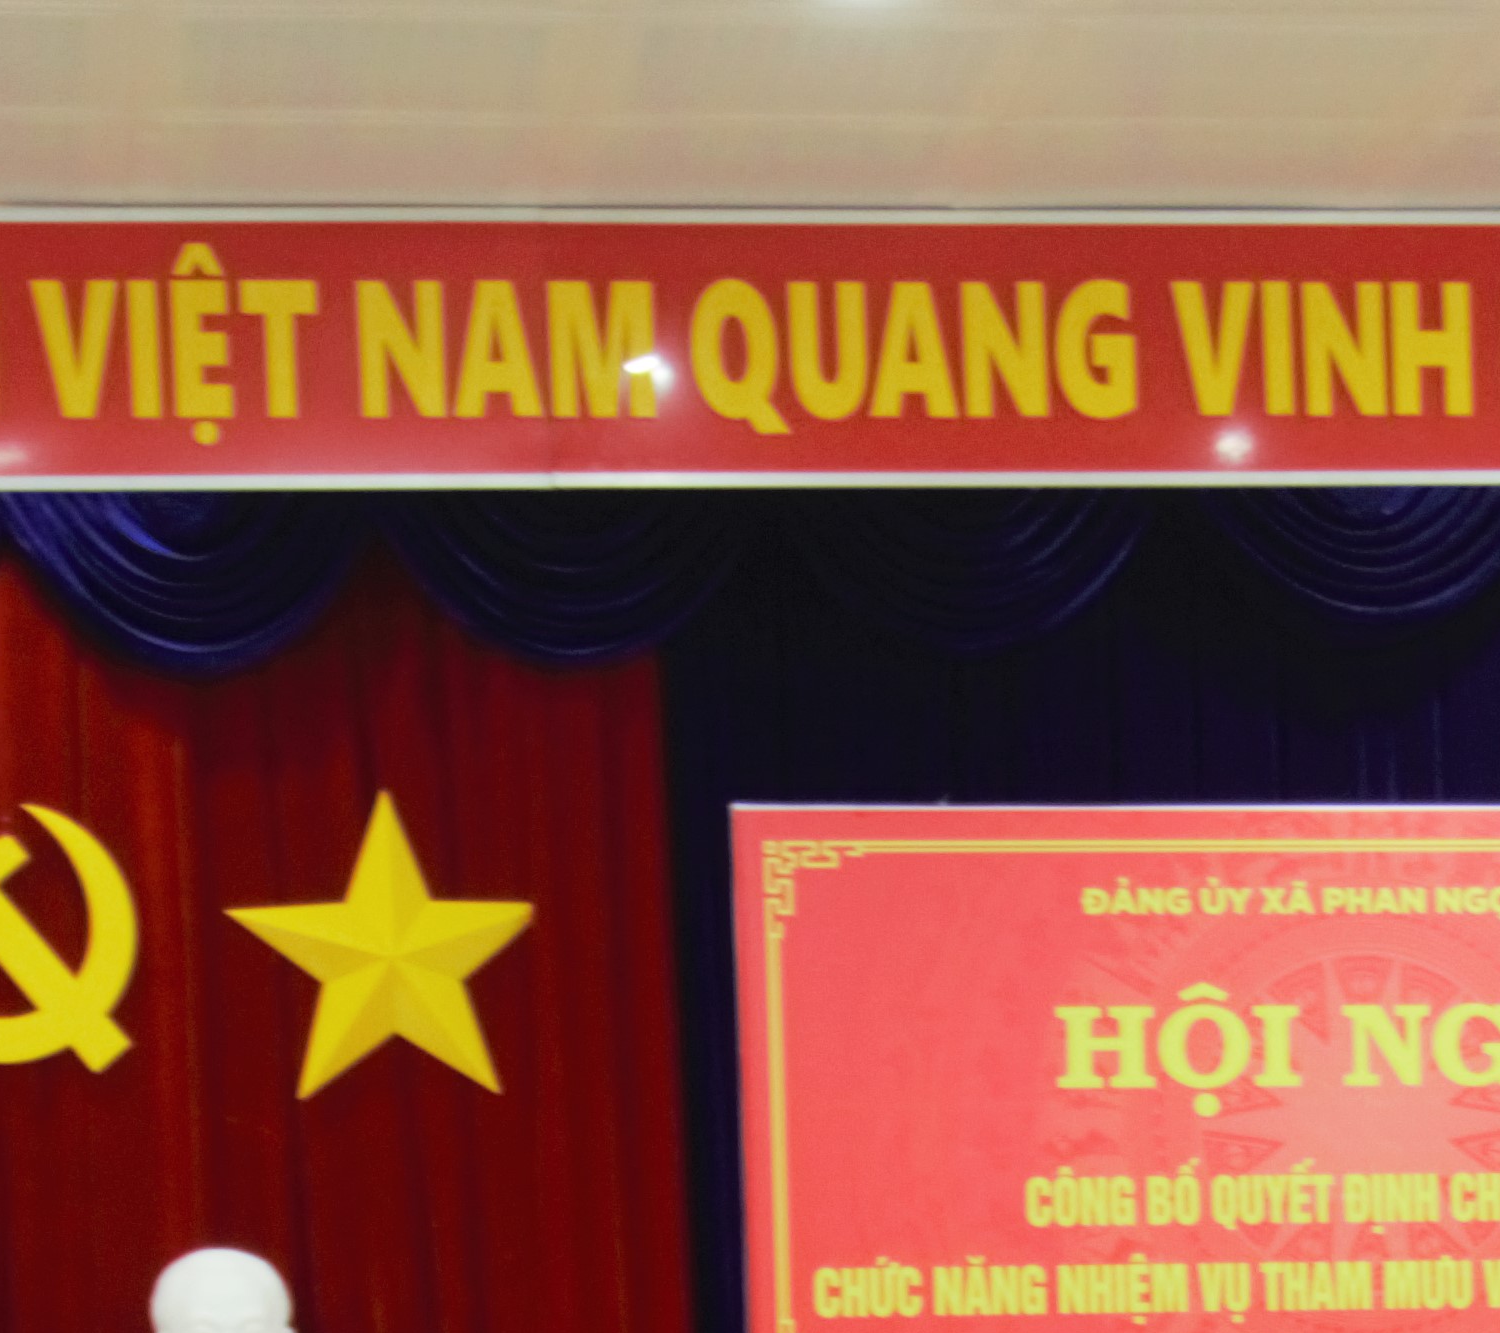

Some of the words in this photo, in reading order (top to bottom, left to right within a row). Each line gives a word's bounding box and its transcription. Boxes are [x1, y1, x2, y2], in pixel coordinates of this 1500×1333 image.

[31, 243, 317, 445] VIỆT
[357, 281, 658, 418] NAM
[690, 279, 1137, 434] QUANG
[1172, 281, 1473, 418] VINH
[1080, 877, 1193, 916] ĐẢNG
[1260, 880, 1315, 915] XÃ
[1322, 886, 1428, 914] PHAN
[1055, 982, 1304, 1118] HỘI
[1025, 1165, 1137, 1228] CÔNG
[1146, 1157, 1201, 1226] BỐ
[1210, 1157, 1337, 1231] QUYẾT
[1341, 1172, 1441, 1234] ĐỊNH
[813, 1256, 924, 1319] CHỨC
[933, 1256, 1048, 1316] NĂNG
[1057, 1252, 1190, 1325] NHIỆM
[1197, 1262, 1252, 1323] VỤ
[1259, 1260, 1374, 1311] THAM
